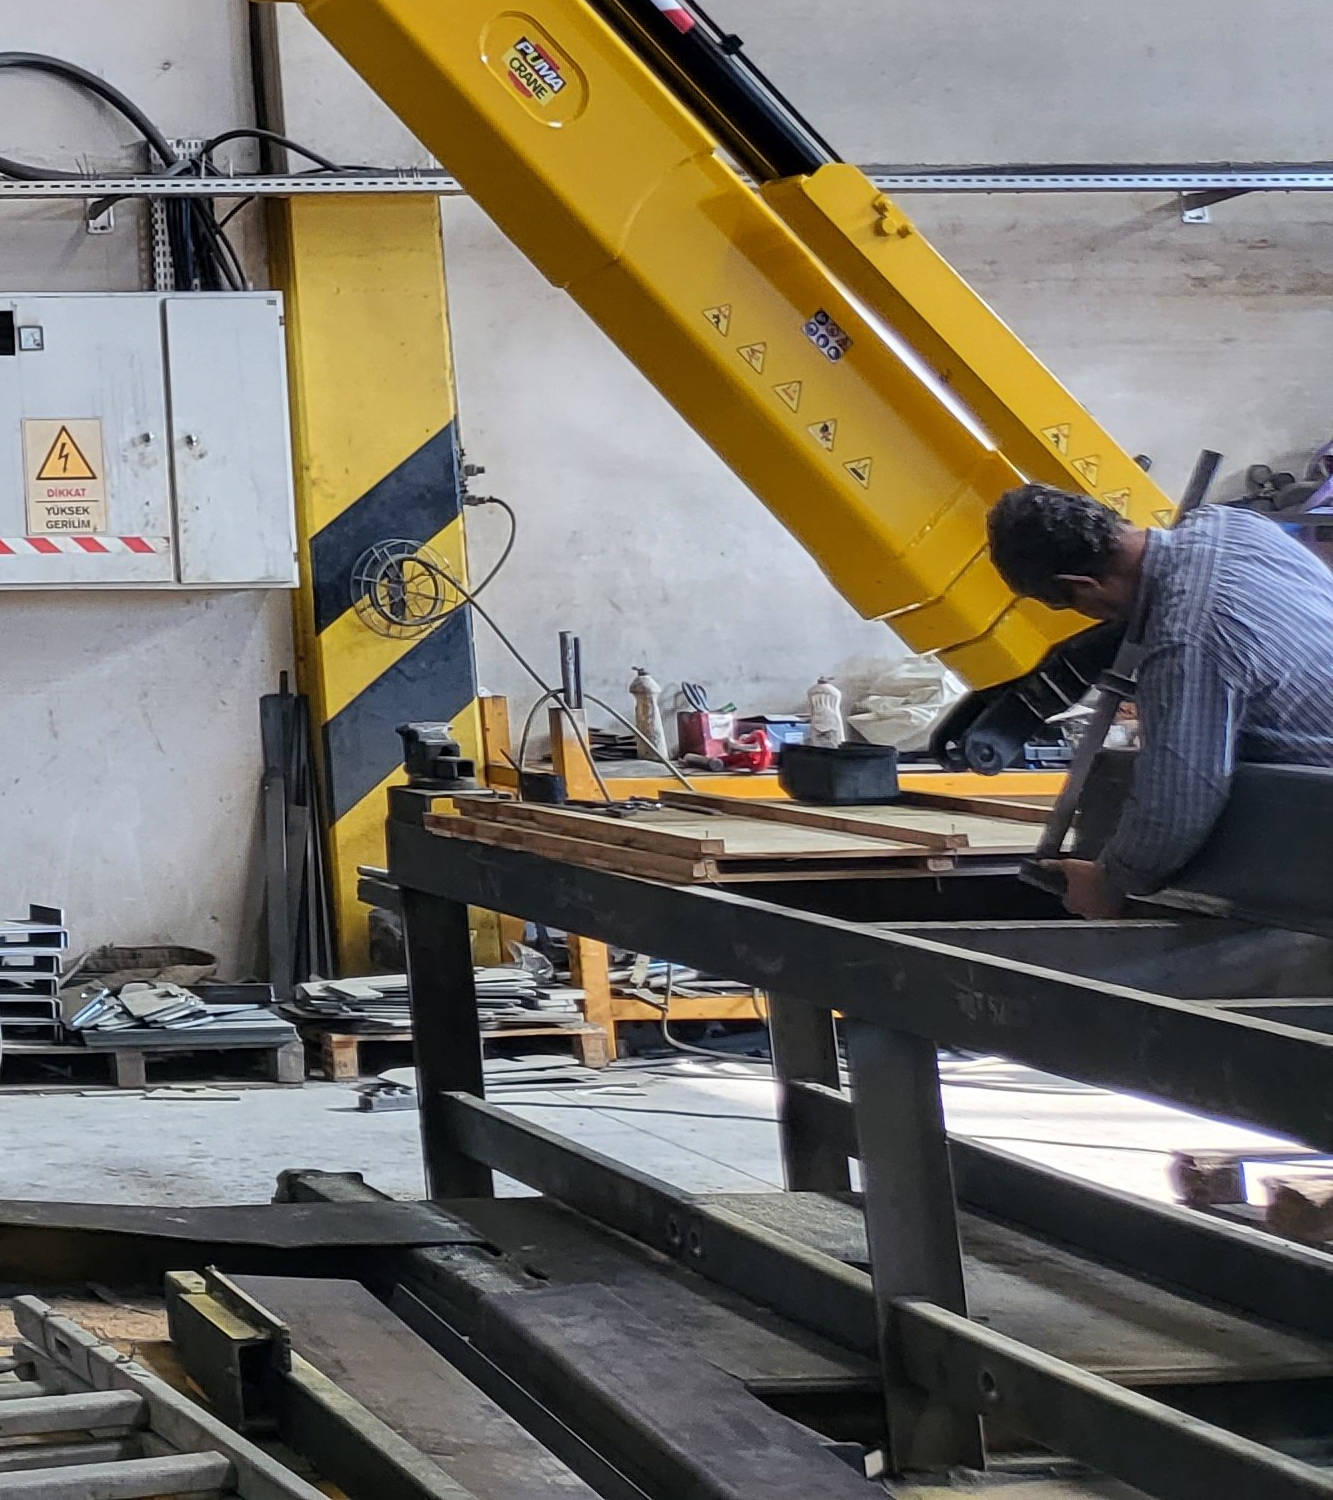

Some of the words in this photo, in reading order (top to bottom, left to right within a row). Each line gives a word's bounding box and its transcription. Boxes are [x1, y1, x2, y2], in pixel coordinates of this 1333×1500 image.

[515, 41, 563, 92] PUMA
[509, 57, 548, 100] CRANE
[46, 487, 86, 498] DİKKAT
[45, 504, 91, 516] YÜKSEK
[45, 518, 91, 529] GERİLİM
